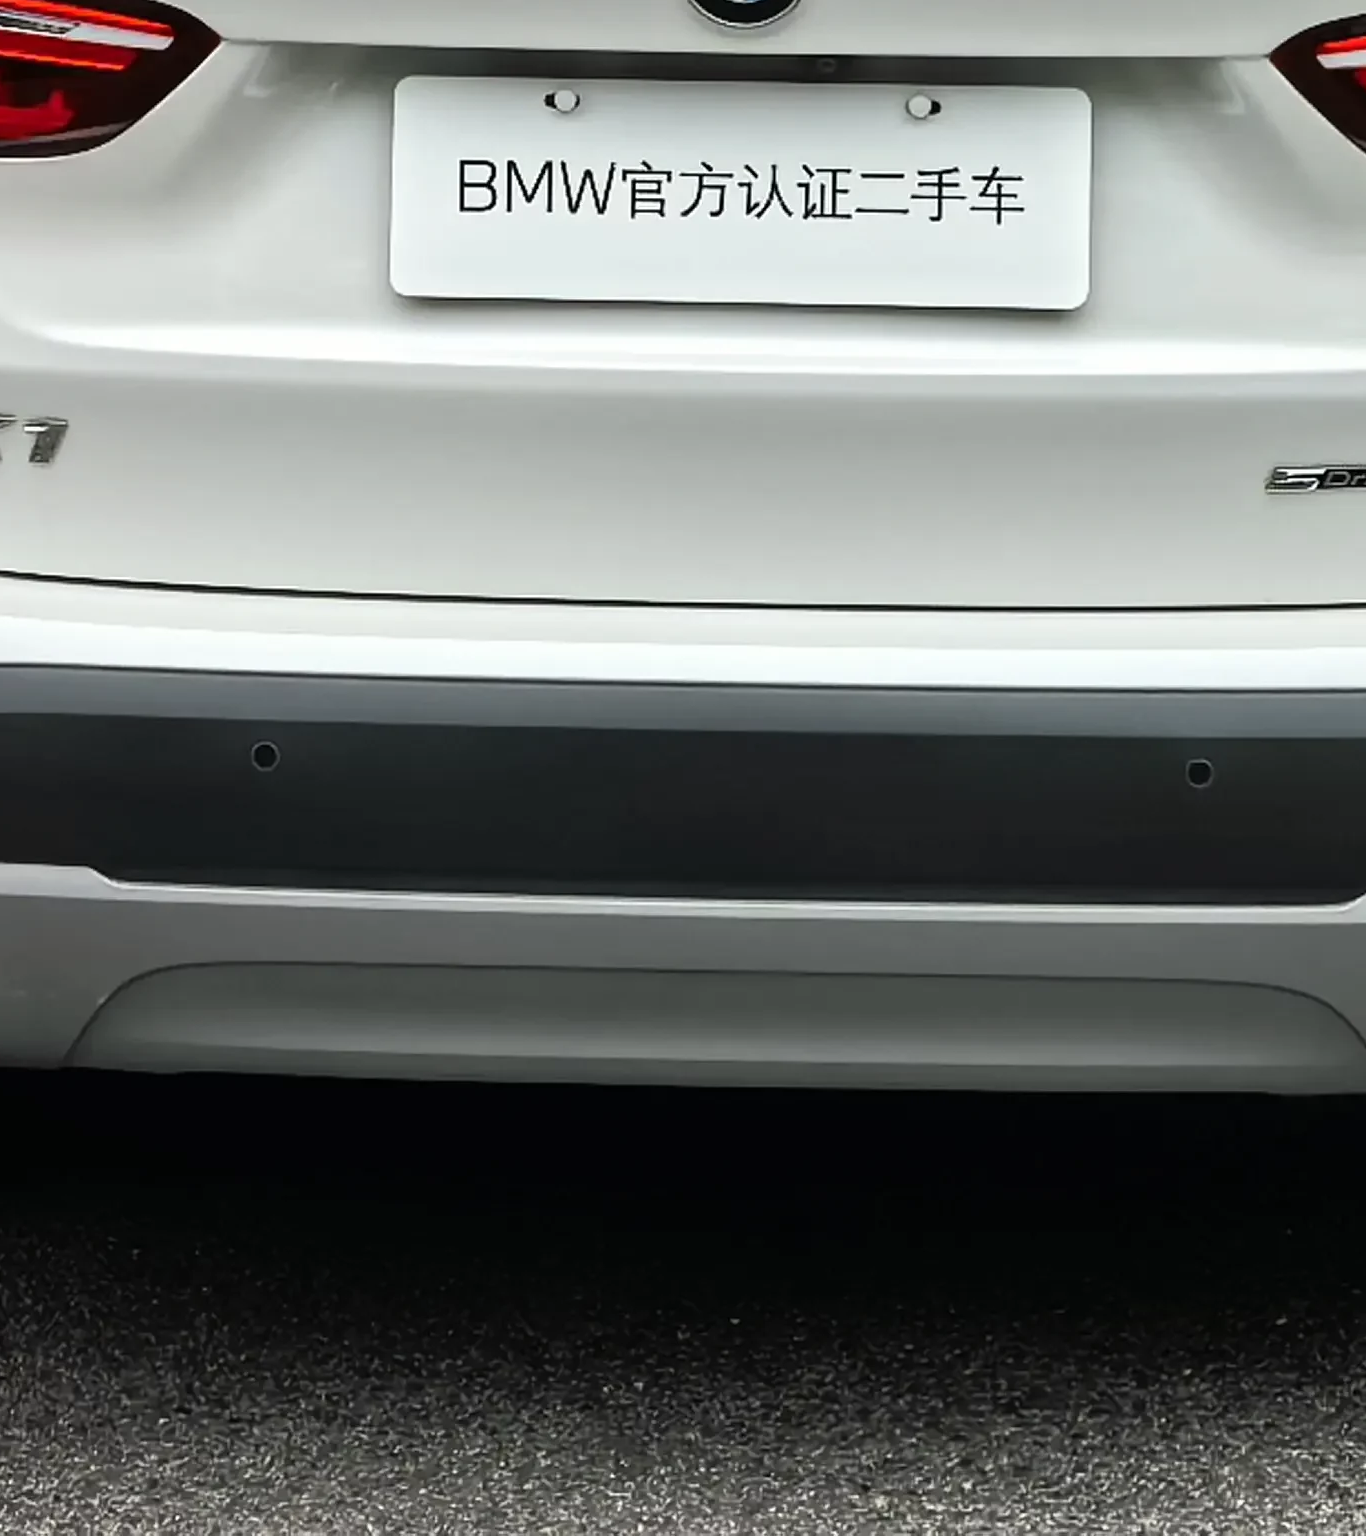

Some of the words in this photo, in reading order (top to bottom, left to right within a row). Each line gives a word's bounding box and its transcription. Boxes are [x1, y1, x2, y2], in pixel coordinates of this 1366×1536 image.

[457, 159, 1027, 226] BMW官方认证二手车
